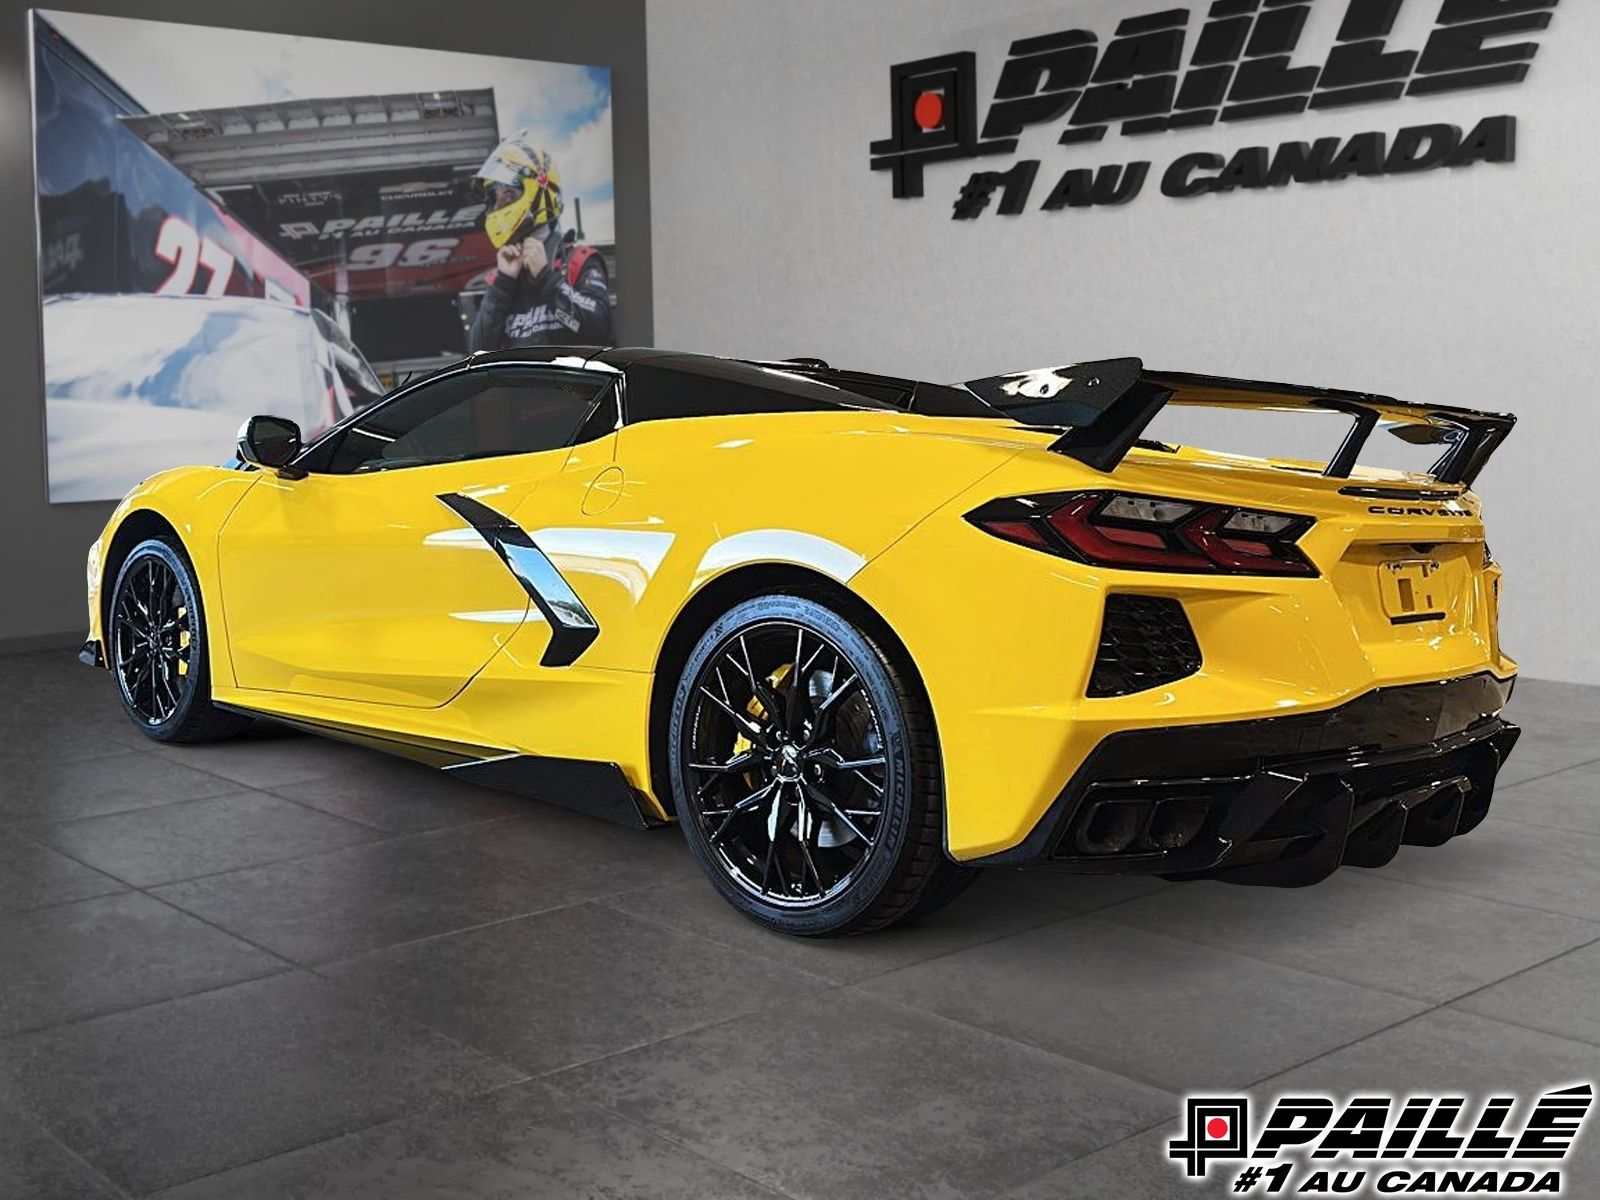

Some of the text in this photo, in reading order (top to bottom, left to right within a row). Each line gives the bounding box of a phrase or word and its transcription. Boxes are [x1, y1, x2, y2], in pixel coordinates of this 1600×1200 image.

[952, 115, 1517, 221] #1 AU CANADA
[388, 221, 476, 235] CANADA
[154, 213, 235, 296] 27
[346, 238, 460, 271] 96
[1368, 505, 1473, 518] CORVETTE
